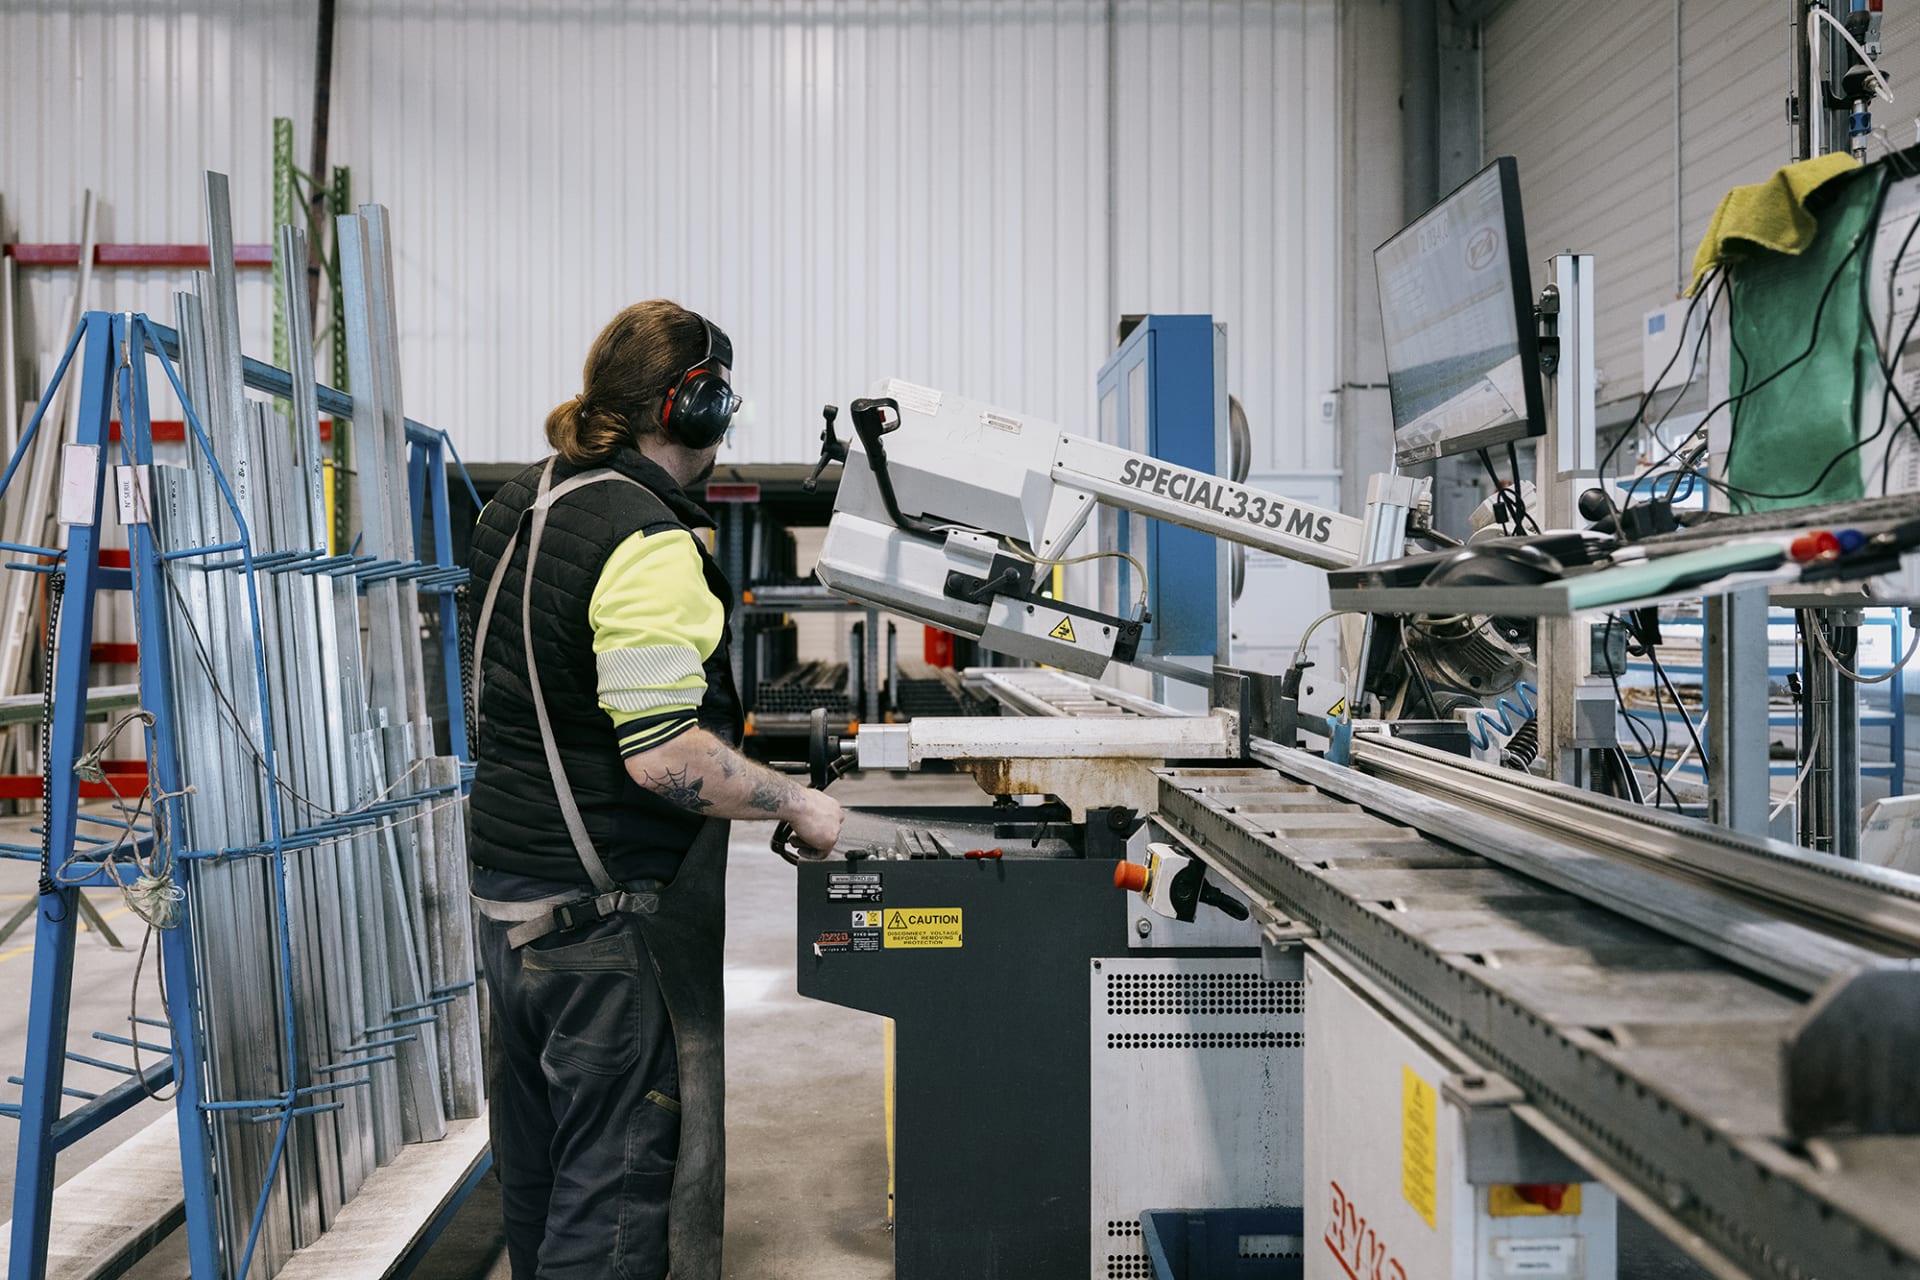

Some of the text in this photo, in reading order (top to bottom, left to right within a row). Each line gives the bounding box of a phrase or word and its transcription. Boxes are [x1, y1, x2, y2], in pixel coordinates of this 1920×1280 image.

[1119, 458, 1332, 544] SPECIAL 335 MS
[908, 914, 959, 925] CAUTION
